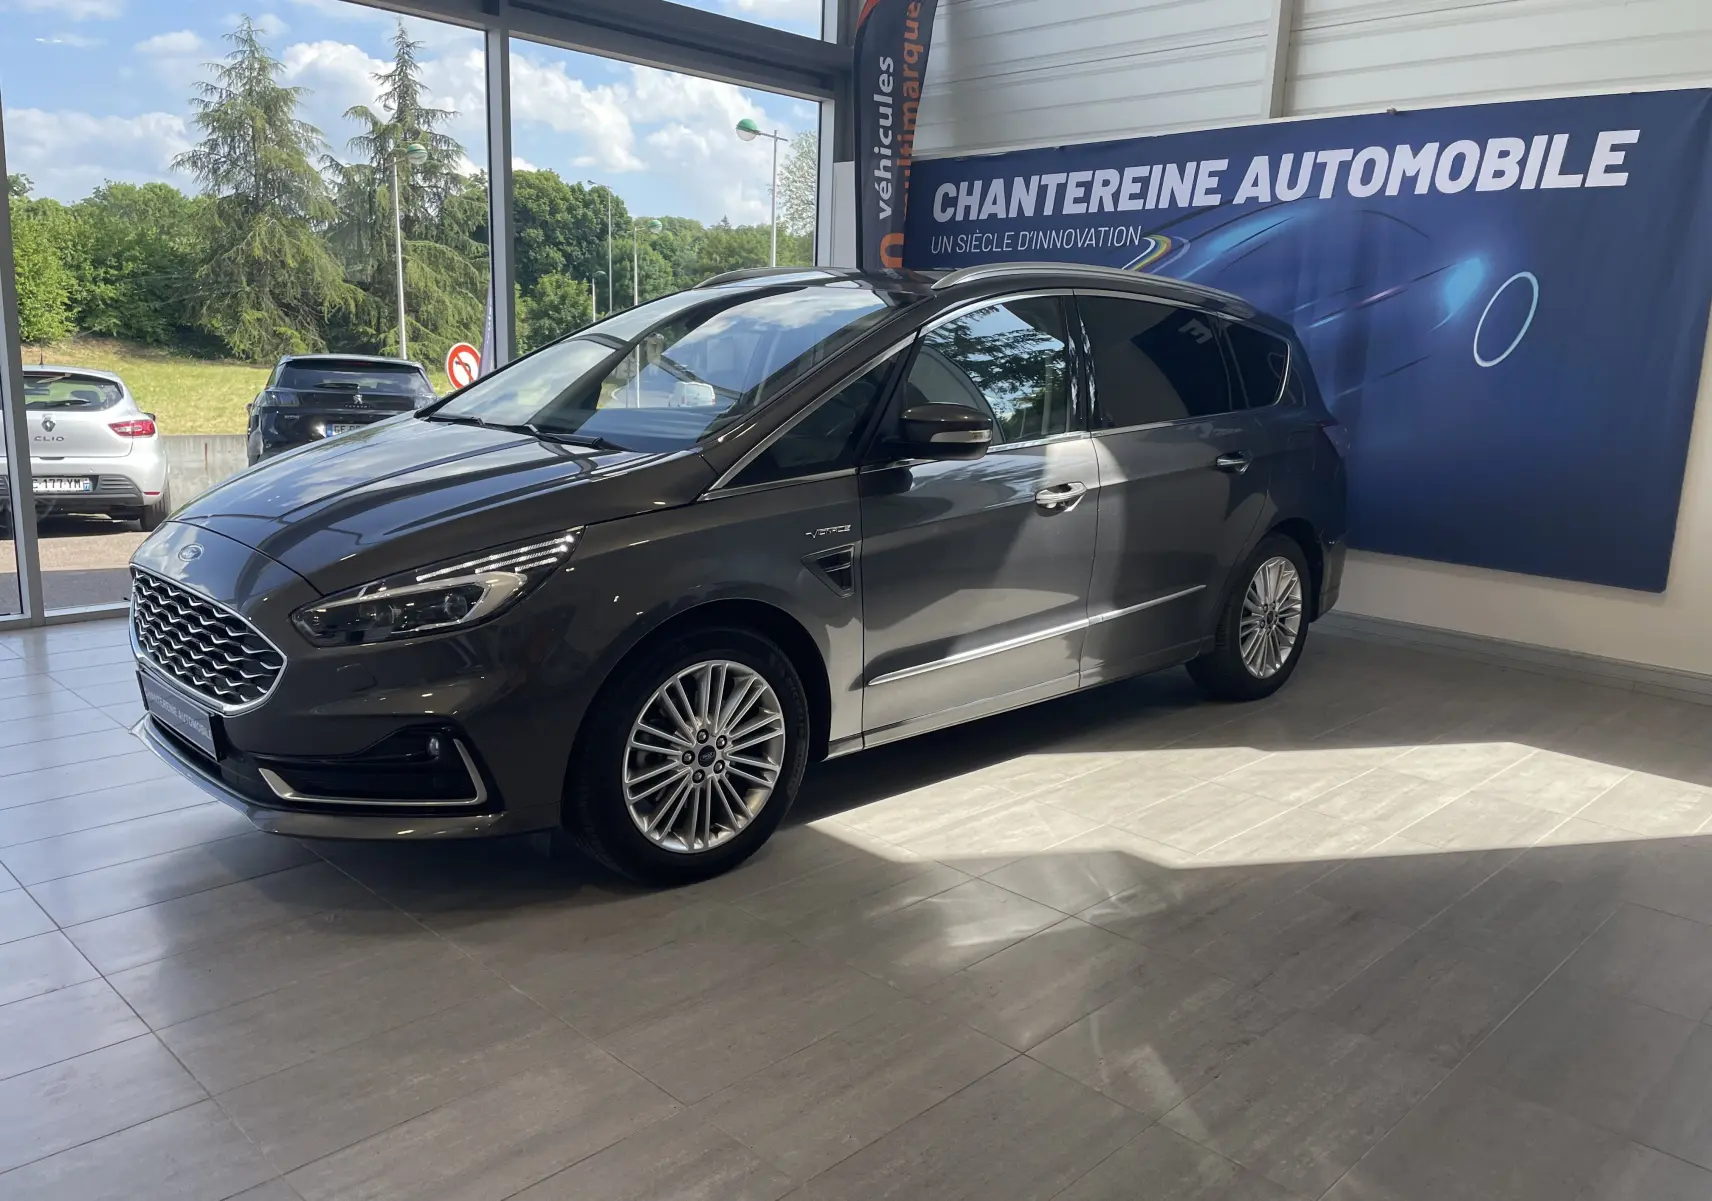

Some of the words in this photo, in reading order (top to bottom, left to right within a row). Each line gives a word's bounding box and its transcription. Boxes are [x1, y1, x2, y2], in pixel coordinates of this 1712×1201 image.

[873, 56, 894, 220] véhicules
[896, 0, 924, 220] ltimarque
[932, 159, 1228, 222] CHANTEREINE
[1233, 129, 1640, 204] AUTOMOBILE
[931, 235, 954, 254] UN
[956, 229, 1015, 253] SIÈCLE
[1017, 226, 1142, 251] D'INNOVATION
